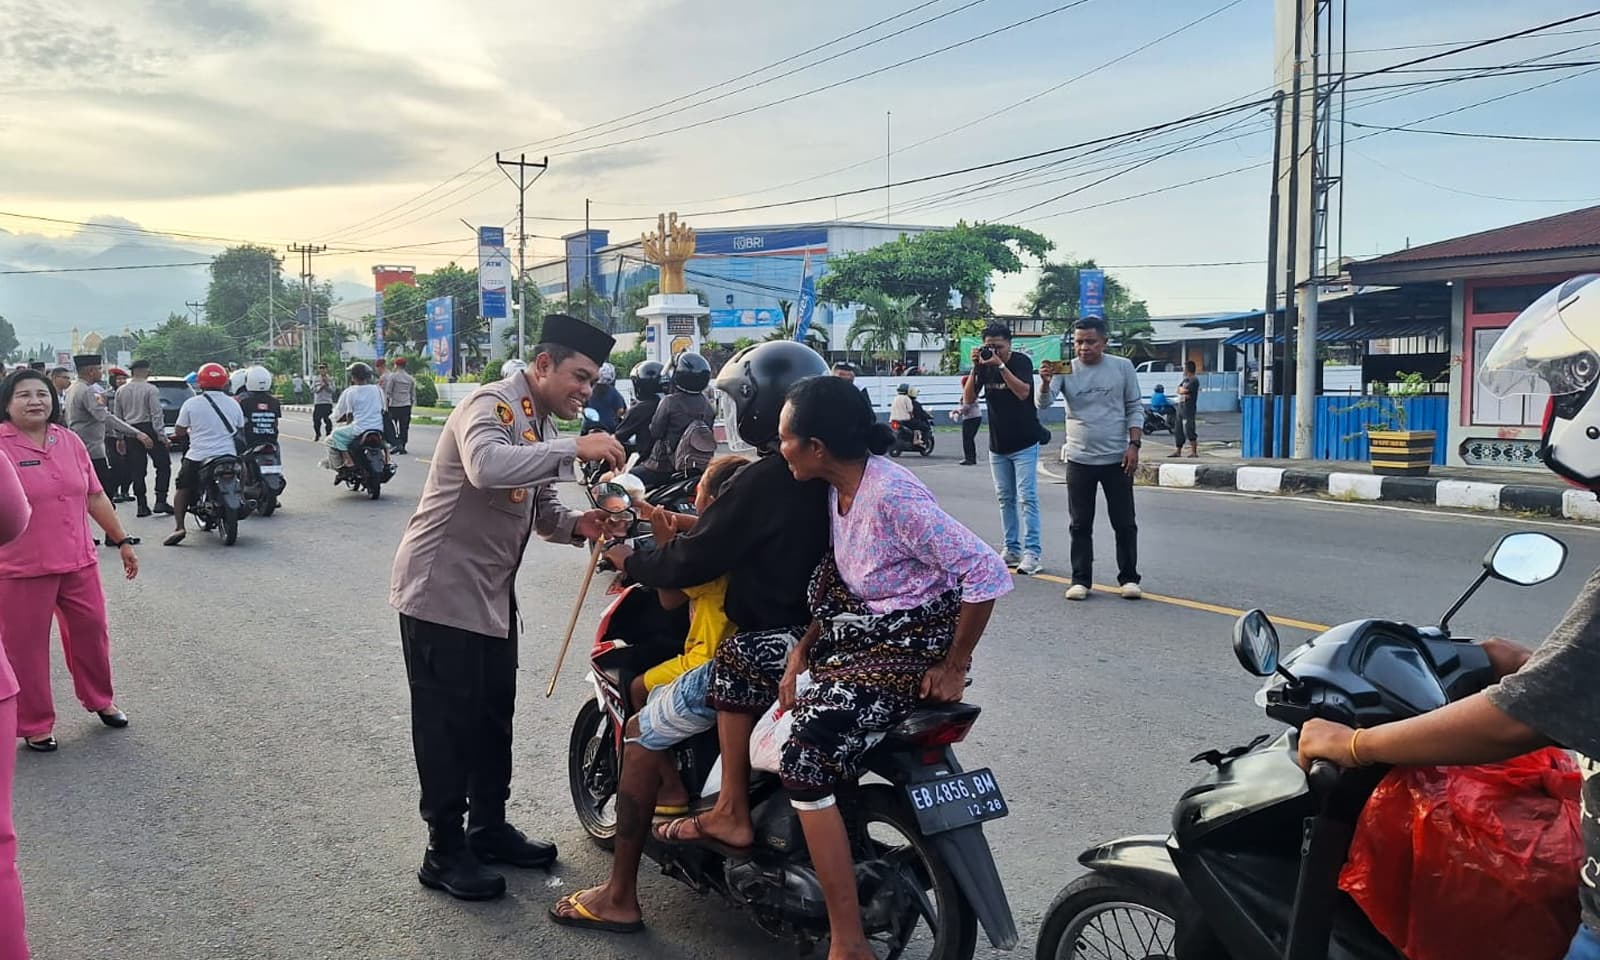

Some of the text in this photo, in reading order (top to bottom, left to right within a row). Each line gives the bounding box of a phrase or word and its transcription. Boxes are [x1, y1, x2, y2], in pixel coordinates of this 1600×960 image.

[745, 237, 764, 249] BRI
[912, 787, 933, 809] EB
[973, 773, 996, 795] BM
